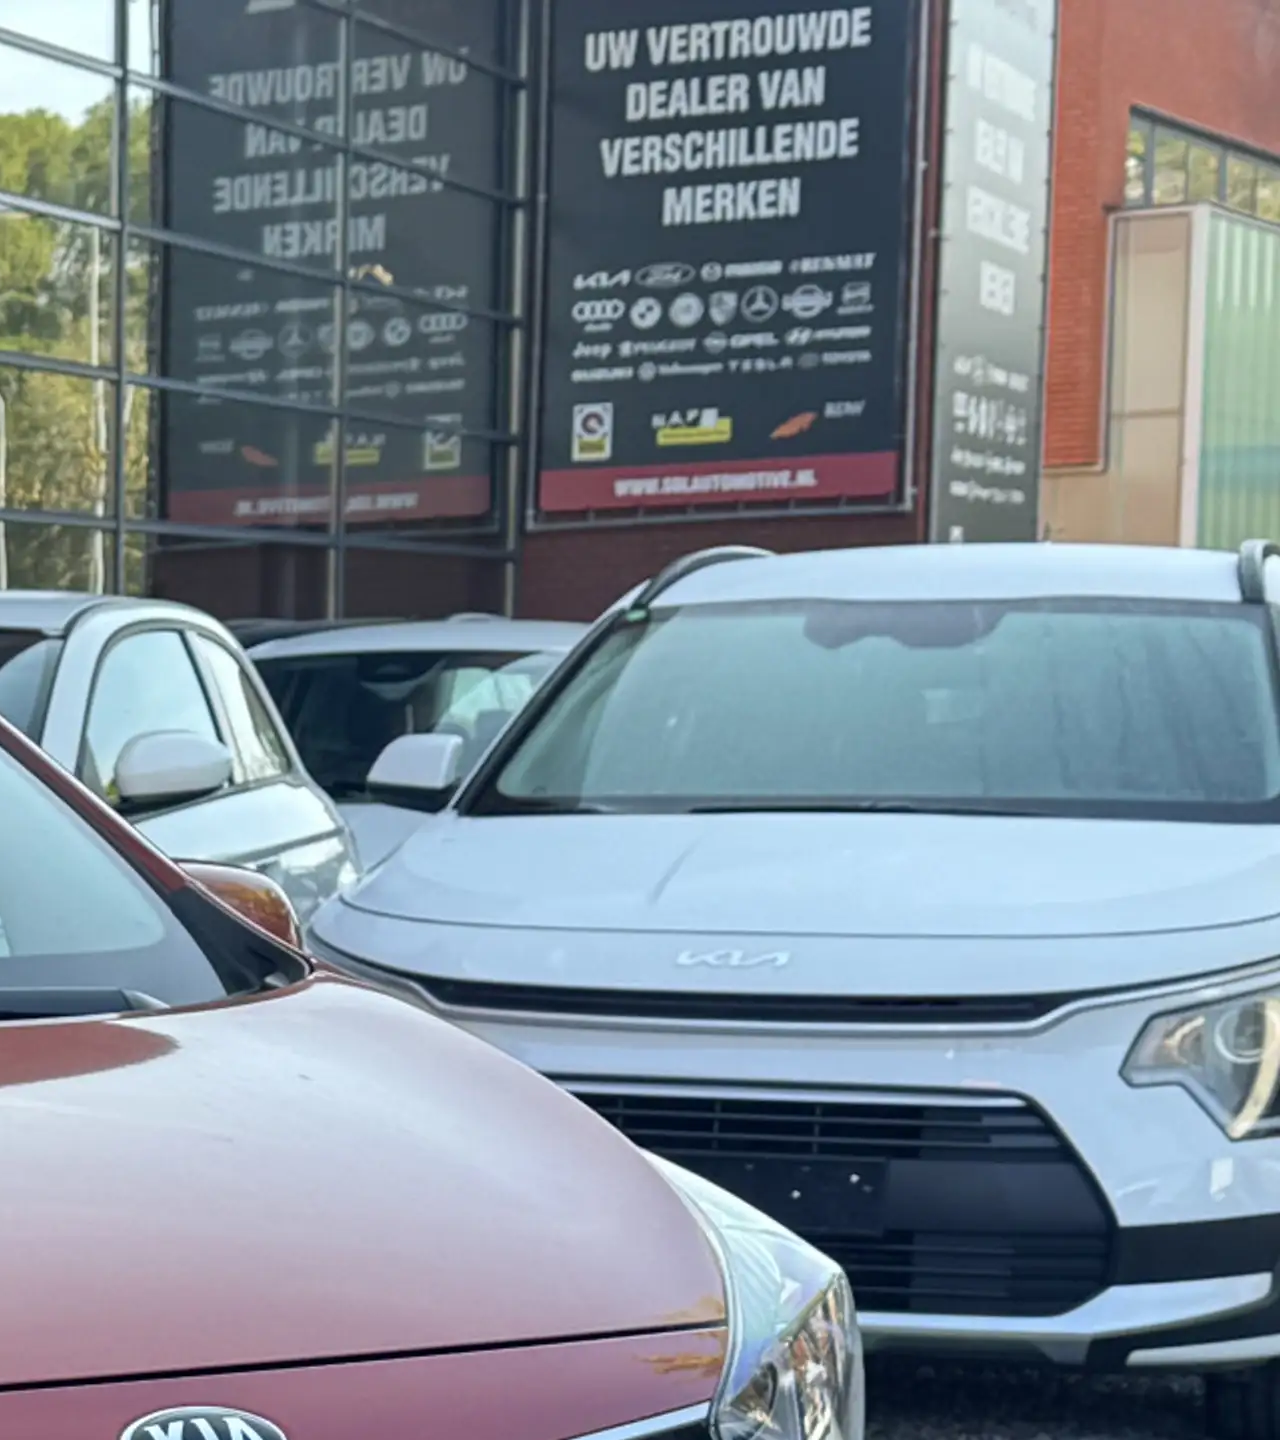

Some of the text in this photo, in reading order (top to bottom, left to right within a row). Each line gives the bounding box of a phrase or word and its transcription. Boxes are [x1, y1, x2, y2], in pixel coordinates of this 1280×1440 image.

[584, 6, 872, 72] UW VERTROUWDE
[625, 65, 826, 122] DEALER VAN
[599, 117, 860, 178] VERSCHILLENDE
[662, 176, 802, 227] MERKEN
